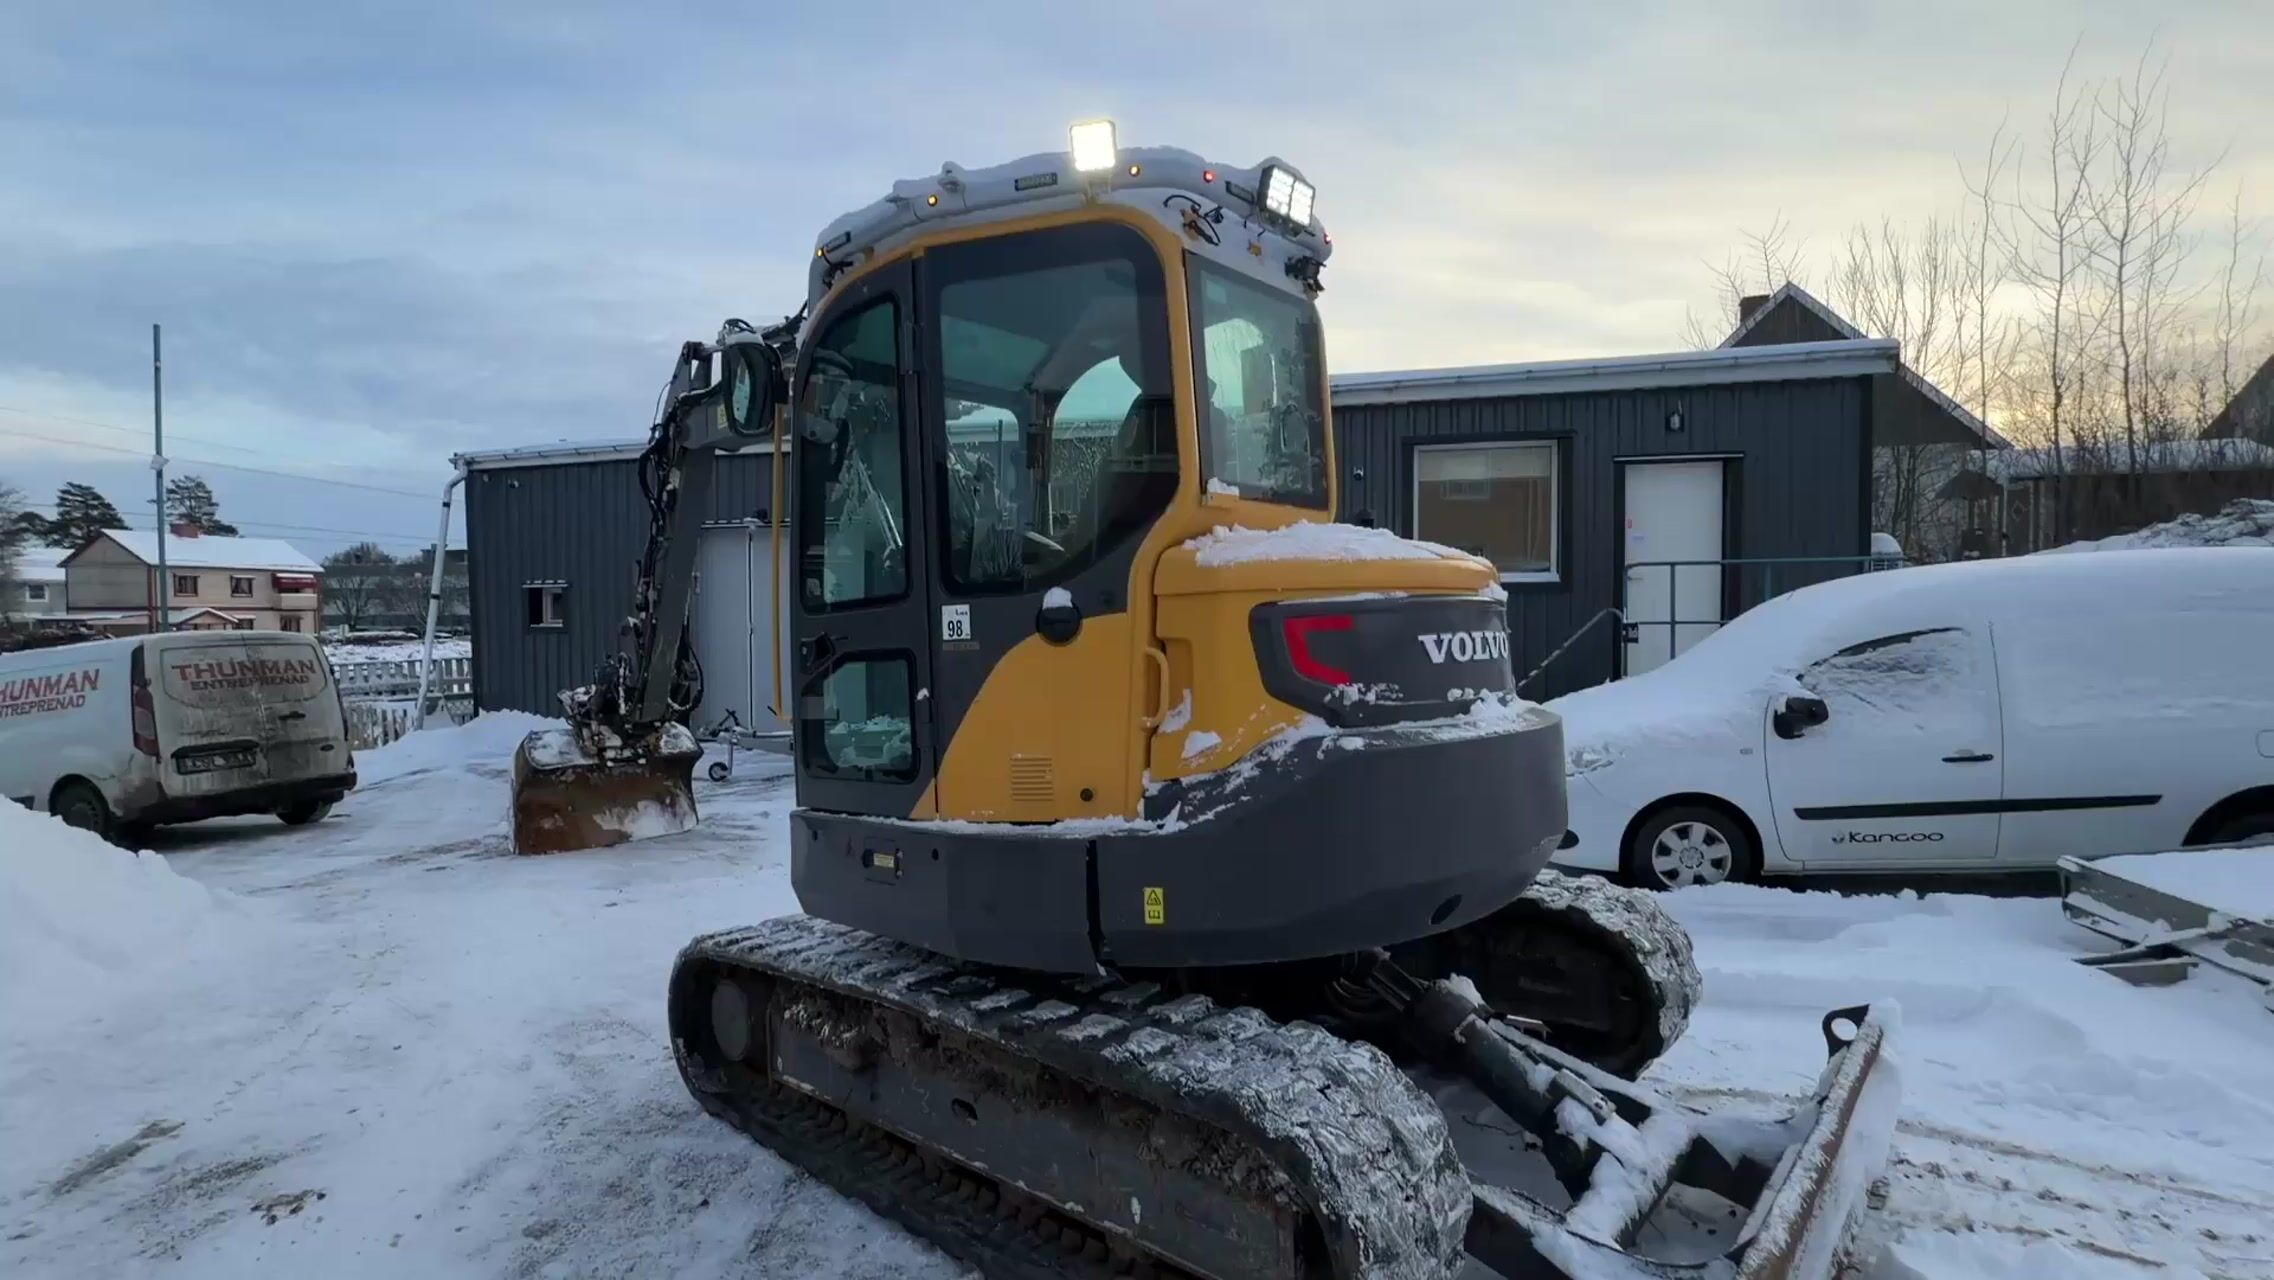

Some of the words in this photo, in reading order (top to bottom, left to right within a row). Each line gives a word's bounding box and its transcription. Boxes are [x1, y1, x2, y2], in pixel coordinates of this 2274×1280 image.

[947, 620, 963, 638] 98
[1418, 631, 1509, 664] VOLVO
[171, 659, 317, 681] THUNMAN
[0, 694, 86, 718] TREPRENAD
